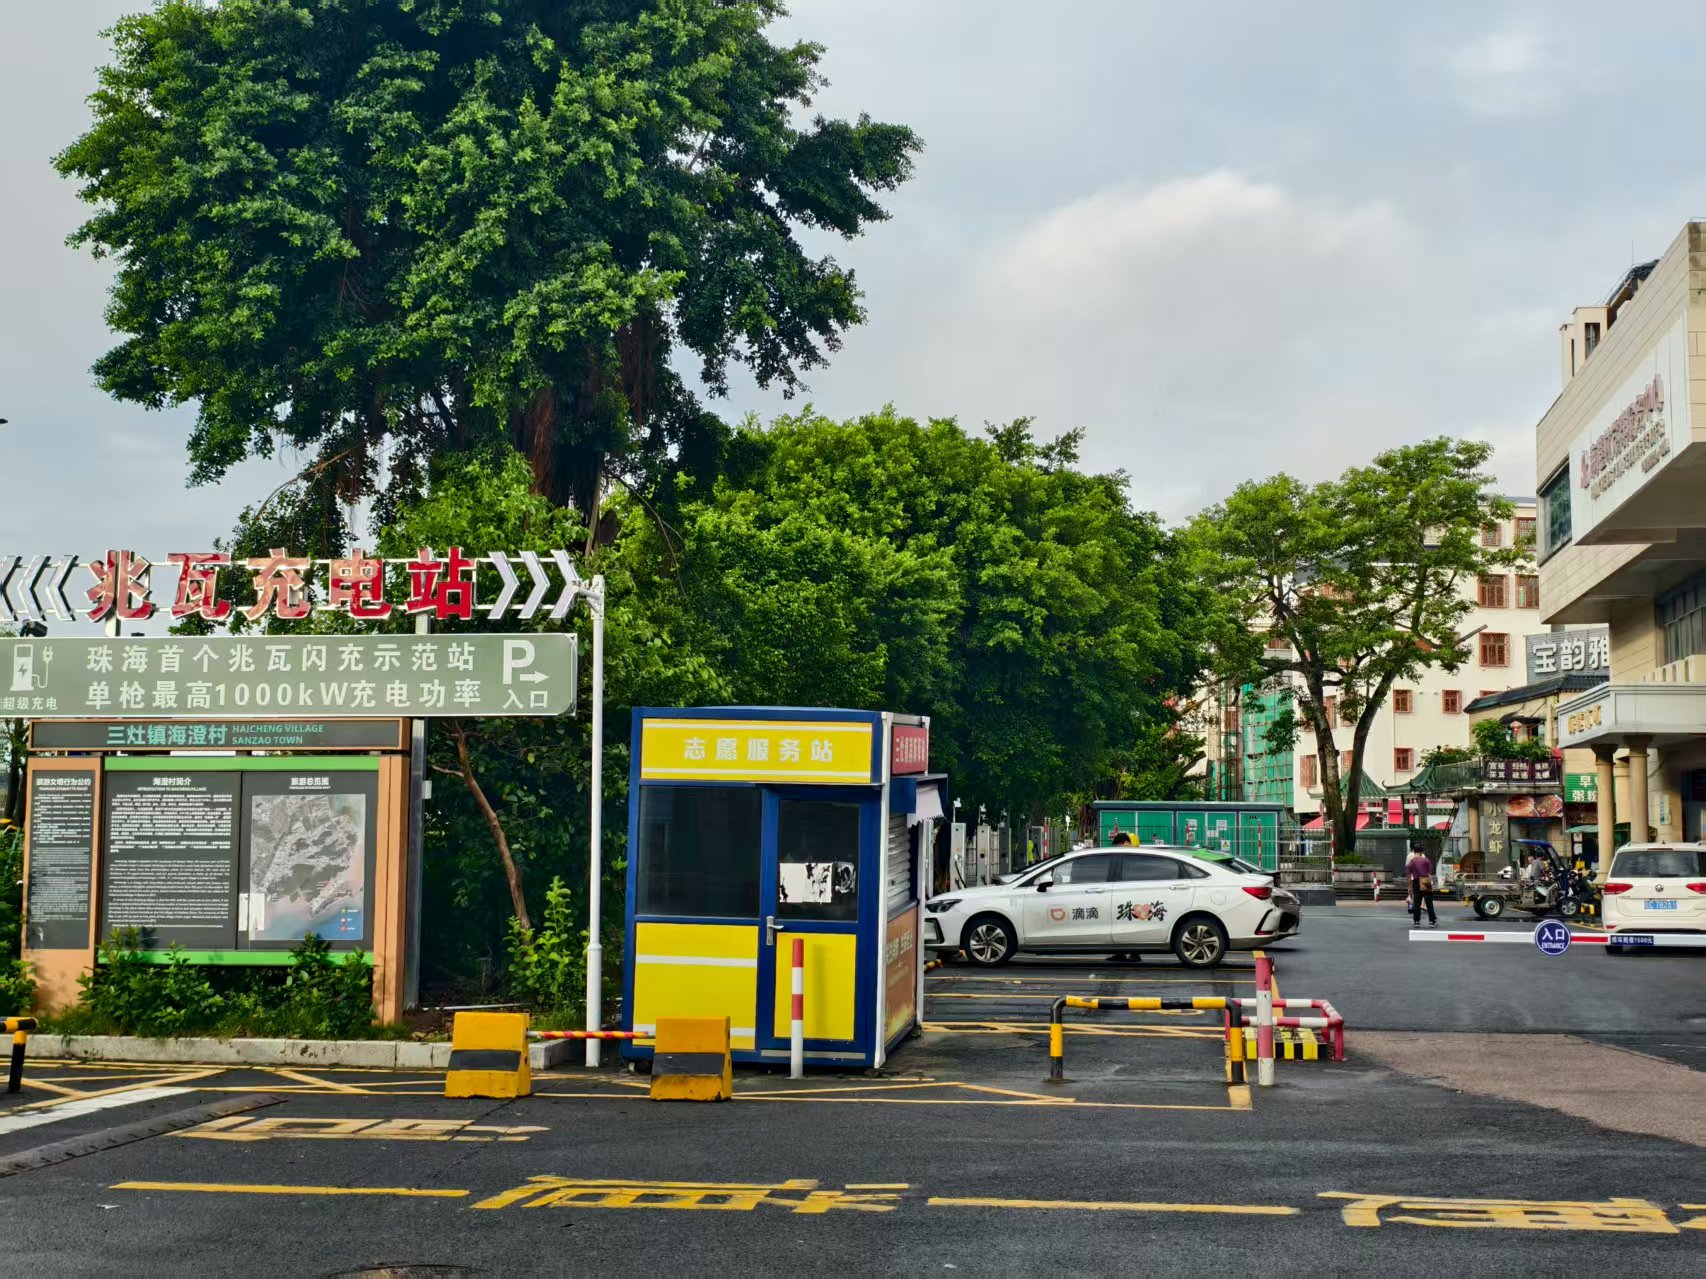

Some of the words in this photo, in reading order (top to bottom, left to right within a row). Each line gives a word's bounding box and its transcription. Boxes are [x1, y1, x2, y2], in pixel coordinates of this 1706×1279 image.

[86, 547, 477, 621] 兆瓦充电站
[87, 644, 476, 673] 珠海首个兆瓦闪充示范站
[502, 639, 536, 685] P
[1532, 635, 1609, 674] 宝韵雅
[0, 696, 58, 711] 超级充电
[86, 680, 482, 710] 单枪最高1000kW充电功率
[502, 689, 548, 709] 入口
[107, 724, 228, 746] 三灶镇海澄村
[232, 724, 283, 733] HAICHENG
[284, 725, 325, 733] VILLAGE
[232, 736, 272, 745] SANZAO
[274, 736, 303, 745] TOWN
[683, 737, 833, 762] 志愿服务站
[1488, 801, 1504, 855] 小龙虾
[1072, 907, 1099, 921] 滴滴
[1541, 928, 1565, 941] 入口
